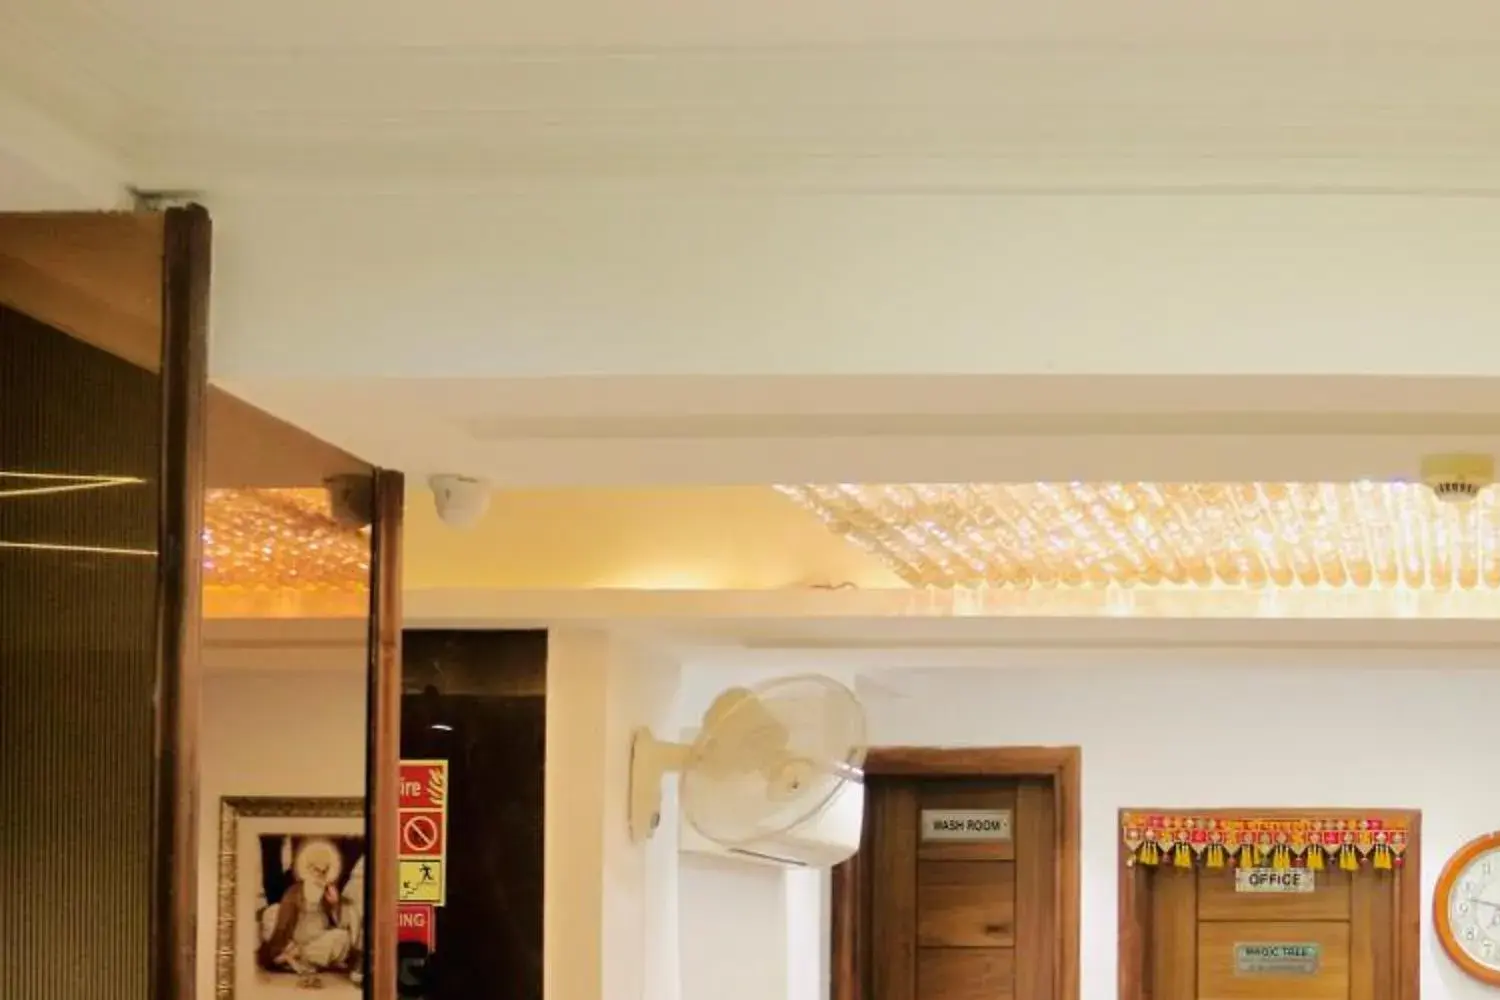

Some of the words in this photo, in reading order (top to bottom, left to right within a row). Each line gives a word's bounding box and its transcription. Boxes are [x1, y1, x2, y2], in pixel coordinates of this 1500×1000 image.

[399, 776, 421, 797] ire
[967, 818, 1000, 831] ROOM
[1248, 873, 1302, 886] OFFICE
